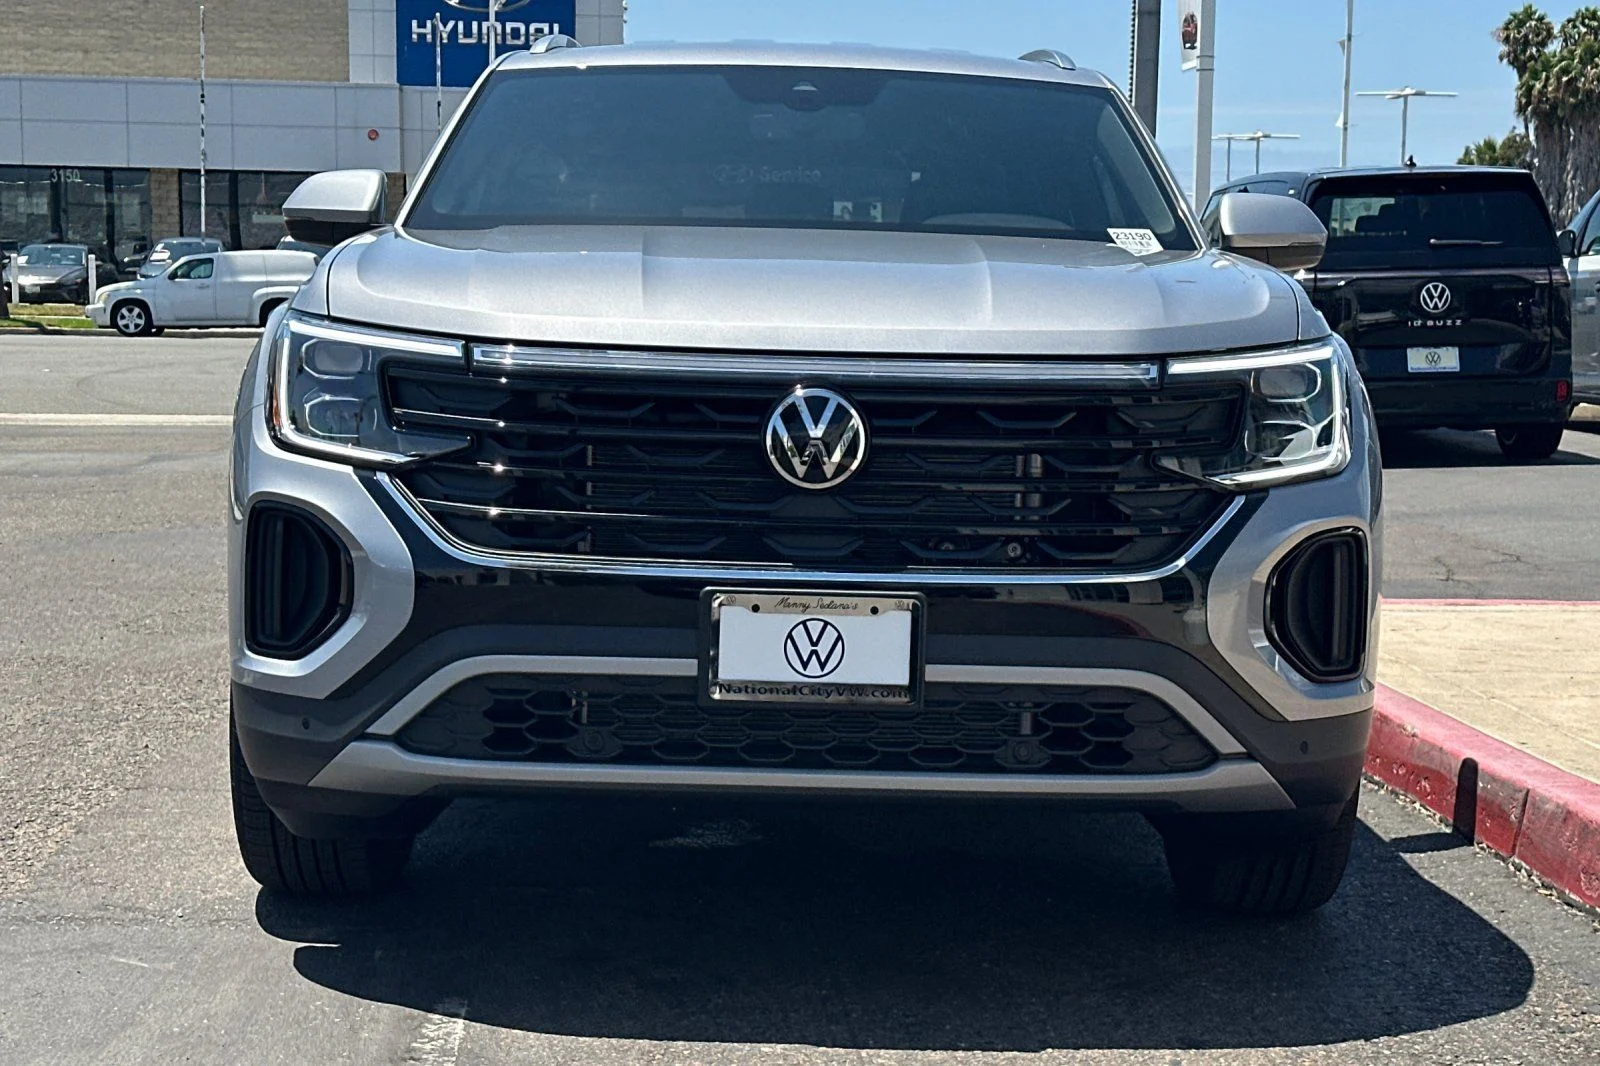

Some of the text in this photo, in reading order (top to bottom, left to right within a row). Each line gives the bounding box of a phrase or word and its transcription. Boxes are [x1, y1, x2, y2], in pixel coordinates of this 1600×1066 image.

[411, 20, 560, 45] HYUNDAI
[51, 168, 80, 183] 3150
[1112, 231, 1152, 241] 23190
[718, 683, 908, 700] NationalCityVW.com
